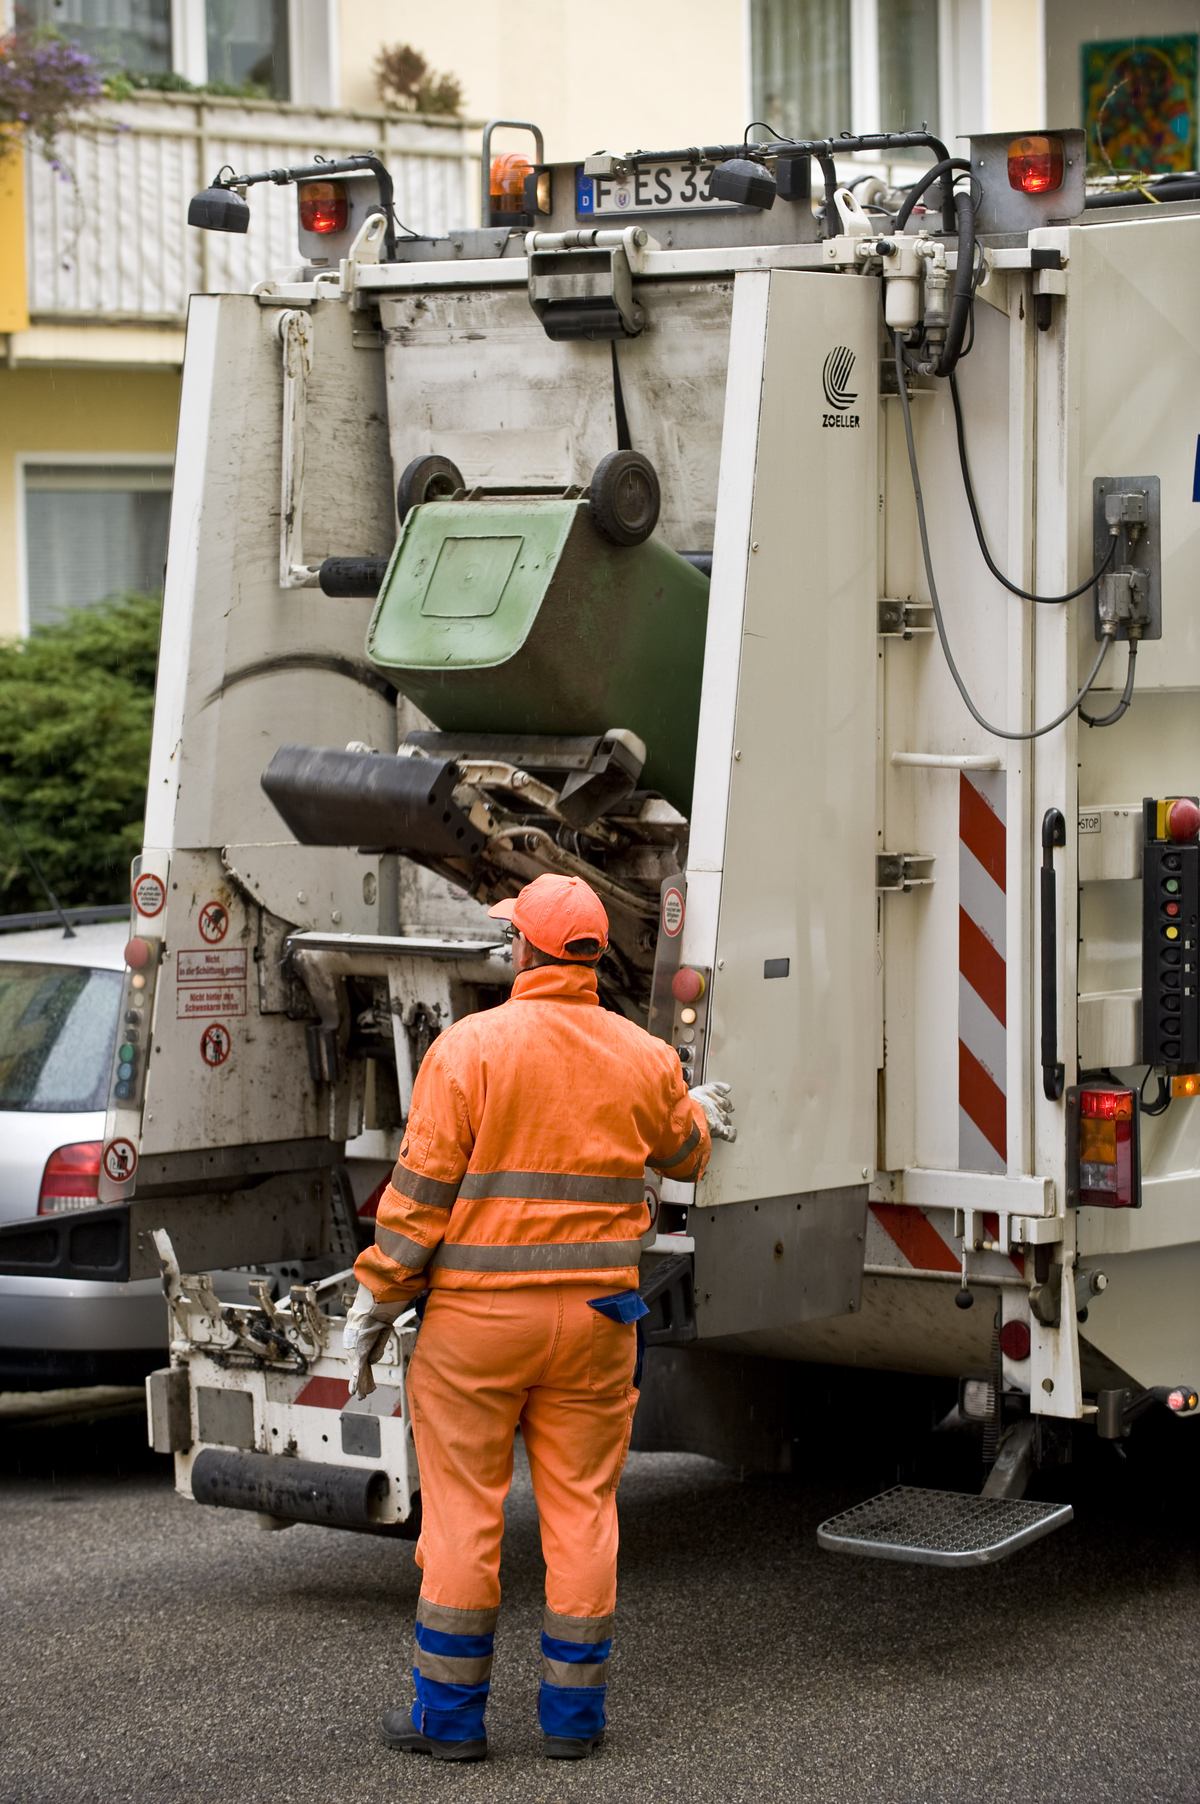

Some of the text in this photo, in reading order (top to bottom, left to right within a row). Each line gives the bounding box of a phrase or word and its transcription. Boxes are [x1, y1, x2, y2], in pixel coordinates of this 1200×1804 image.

[635, 167, 673, 206] ES
[680, 164, 730, 203] 33
[583, 196, 589, 206] D
[822, 414, 860, 428] ZOELLER
[1080, 818, 1098, 829] STOP
[205, 955, 219, 963] Nicht
[190, 993, 205, 1001] Nicht
